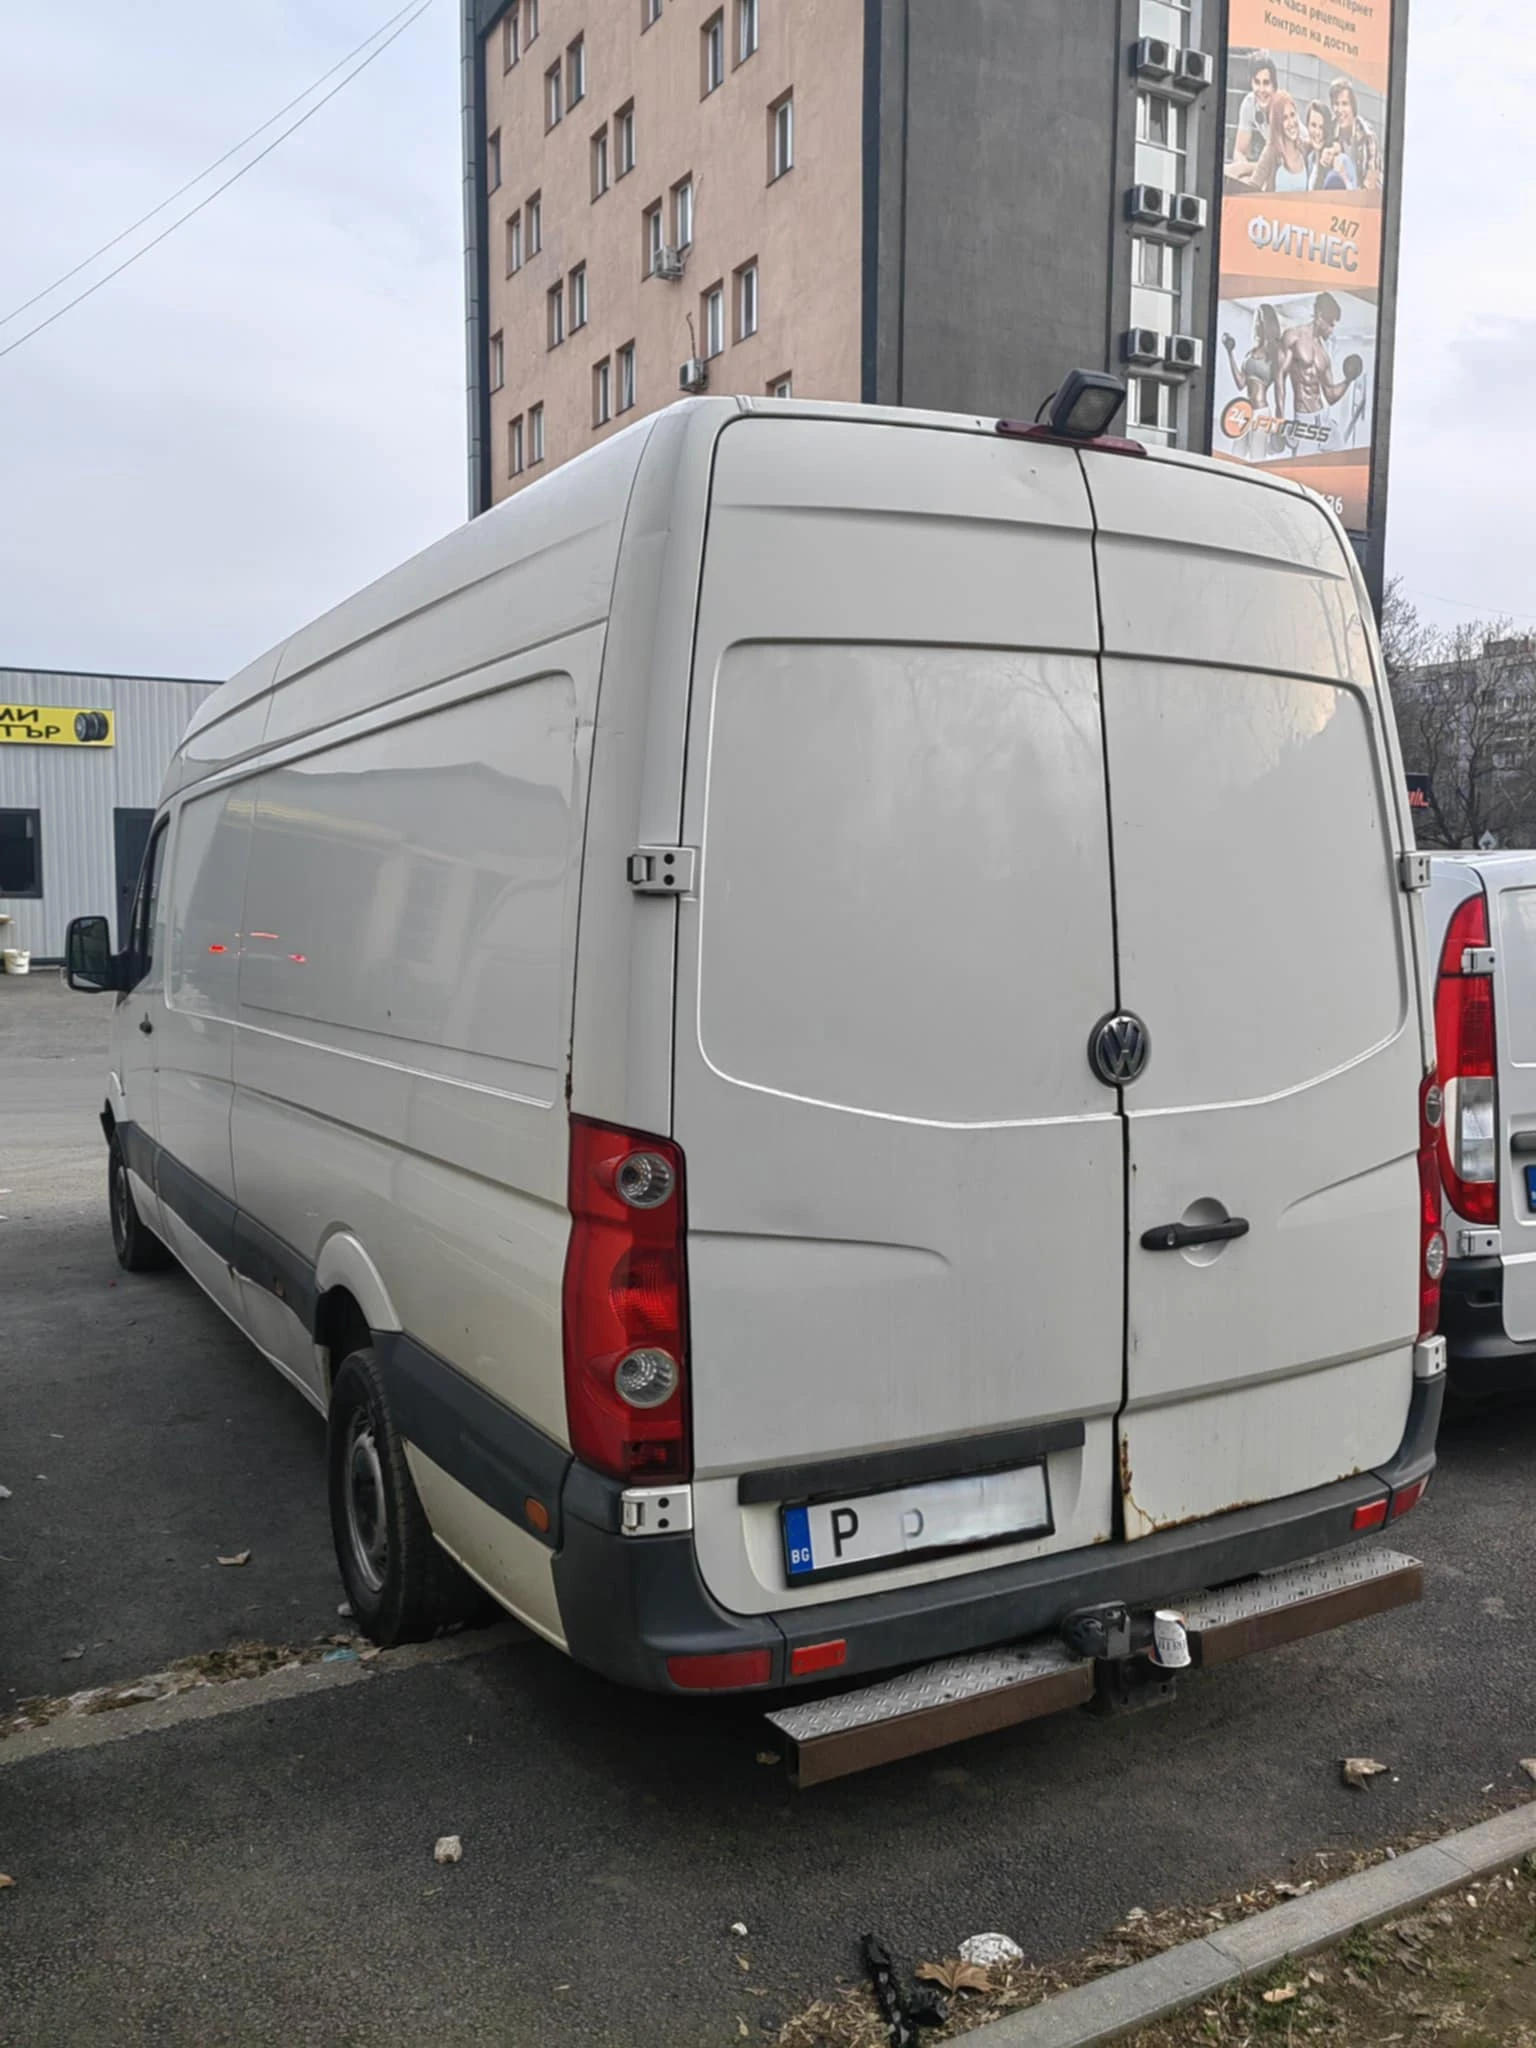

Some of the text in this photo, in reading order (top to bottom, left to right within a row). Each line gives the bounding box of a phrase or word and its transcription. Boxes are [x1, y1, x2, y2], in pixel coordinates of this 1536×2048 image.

[1309, 7, 1356, 33] рецепция
[1264, 10, 1359, 57] Контрол на достъп
[1329, 215, 1360, 239] 24/7
[1247, 214, 1359, 273] ФИТНЕС
[791, 1547, 810, 1565] BG
